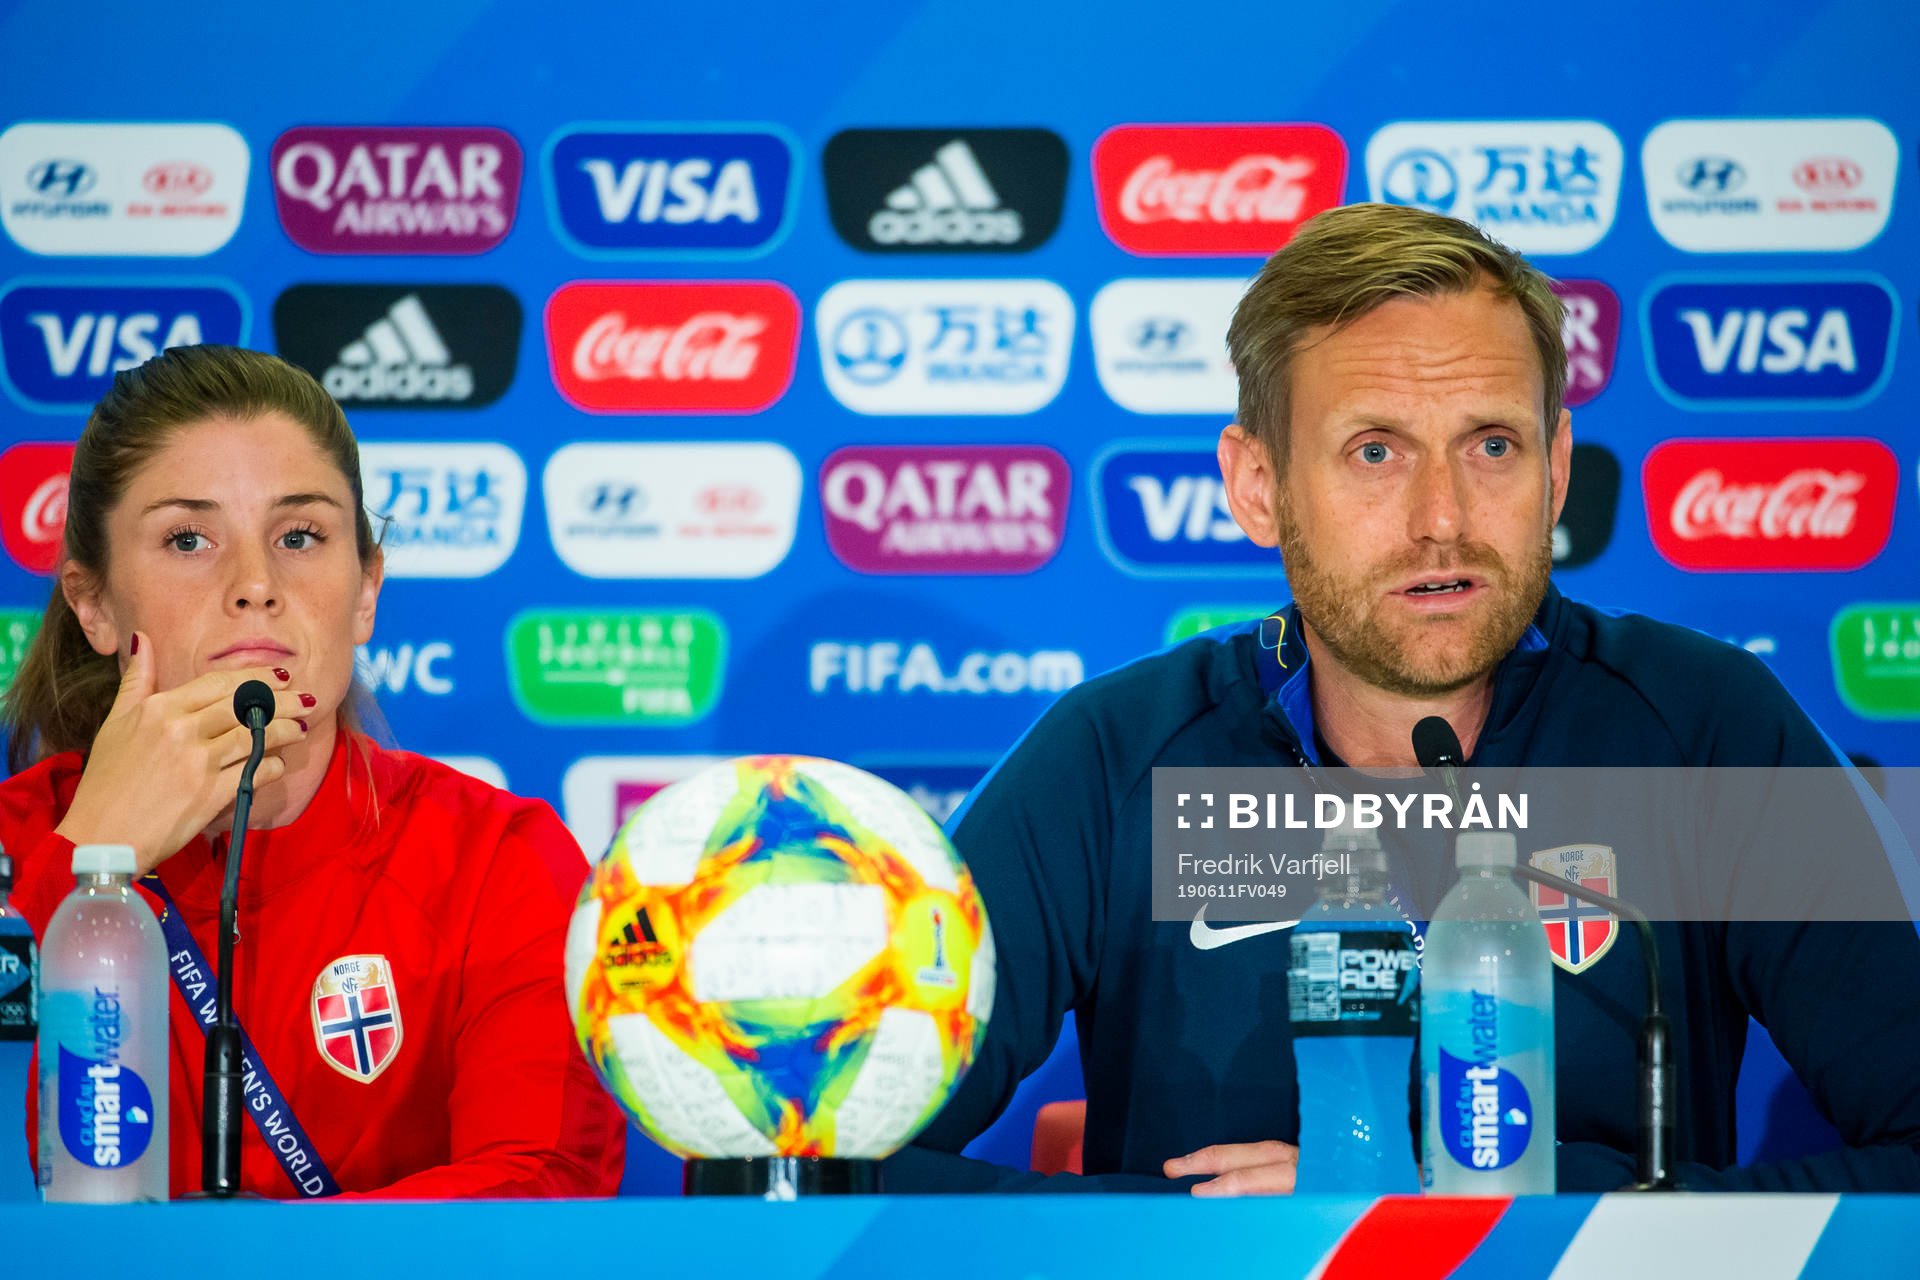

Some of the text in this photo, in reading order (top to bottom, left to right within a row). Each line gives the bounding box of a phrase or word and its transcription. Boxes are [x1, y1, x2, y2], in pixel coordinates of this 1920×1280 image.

[277, 142, 504, 211] QATAR
[580, 159, 760, 223] VISA
[335, 201, 506, 236] AIRWAYS
[869, 208, 1023, 244] adidas
[1679, 309, 1858, 374] VISA
[322, 362, 475, 400] adidas
[824, 461, 1052, 530] QATAR
[1129, 475, 1247, 542] VIS
[809, 643, 1083, 693] FIFA.com
[1560, 850, 1584, 863] NORGE
[334, 961, 360, 976] NORGE
[606, 946, 672, 969] adidas
[1341, 970, 1396, 990] ADE
[171, 950, 207, 1001] FIFA
[264, 1110, 324, 1196] WORLD
